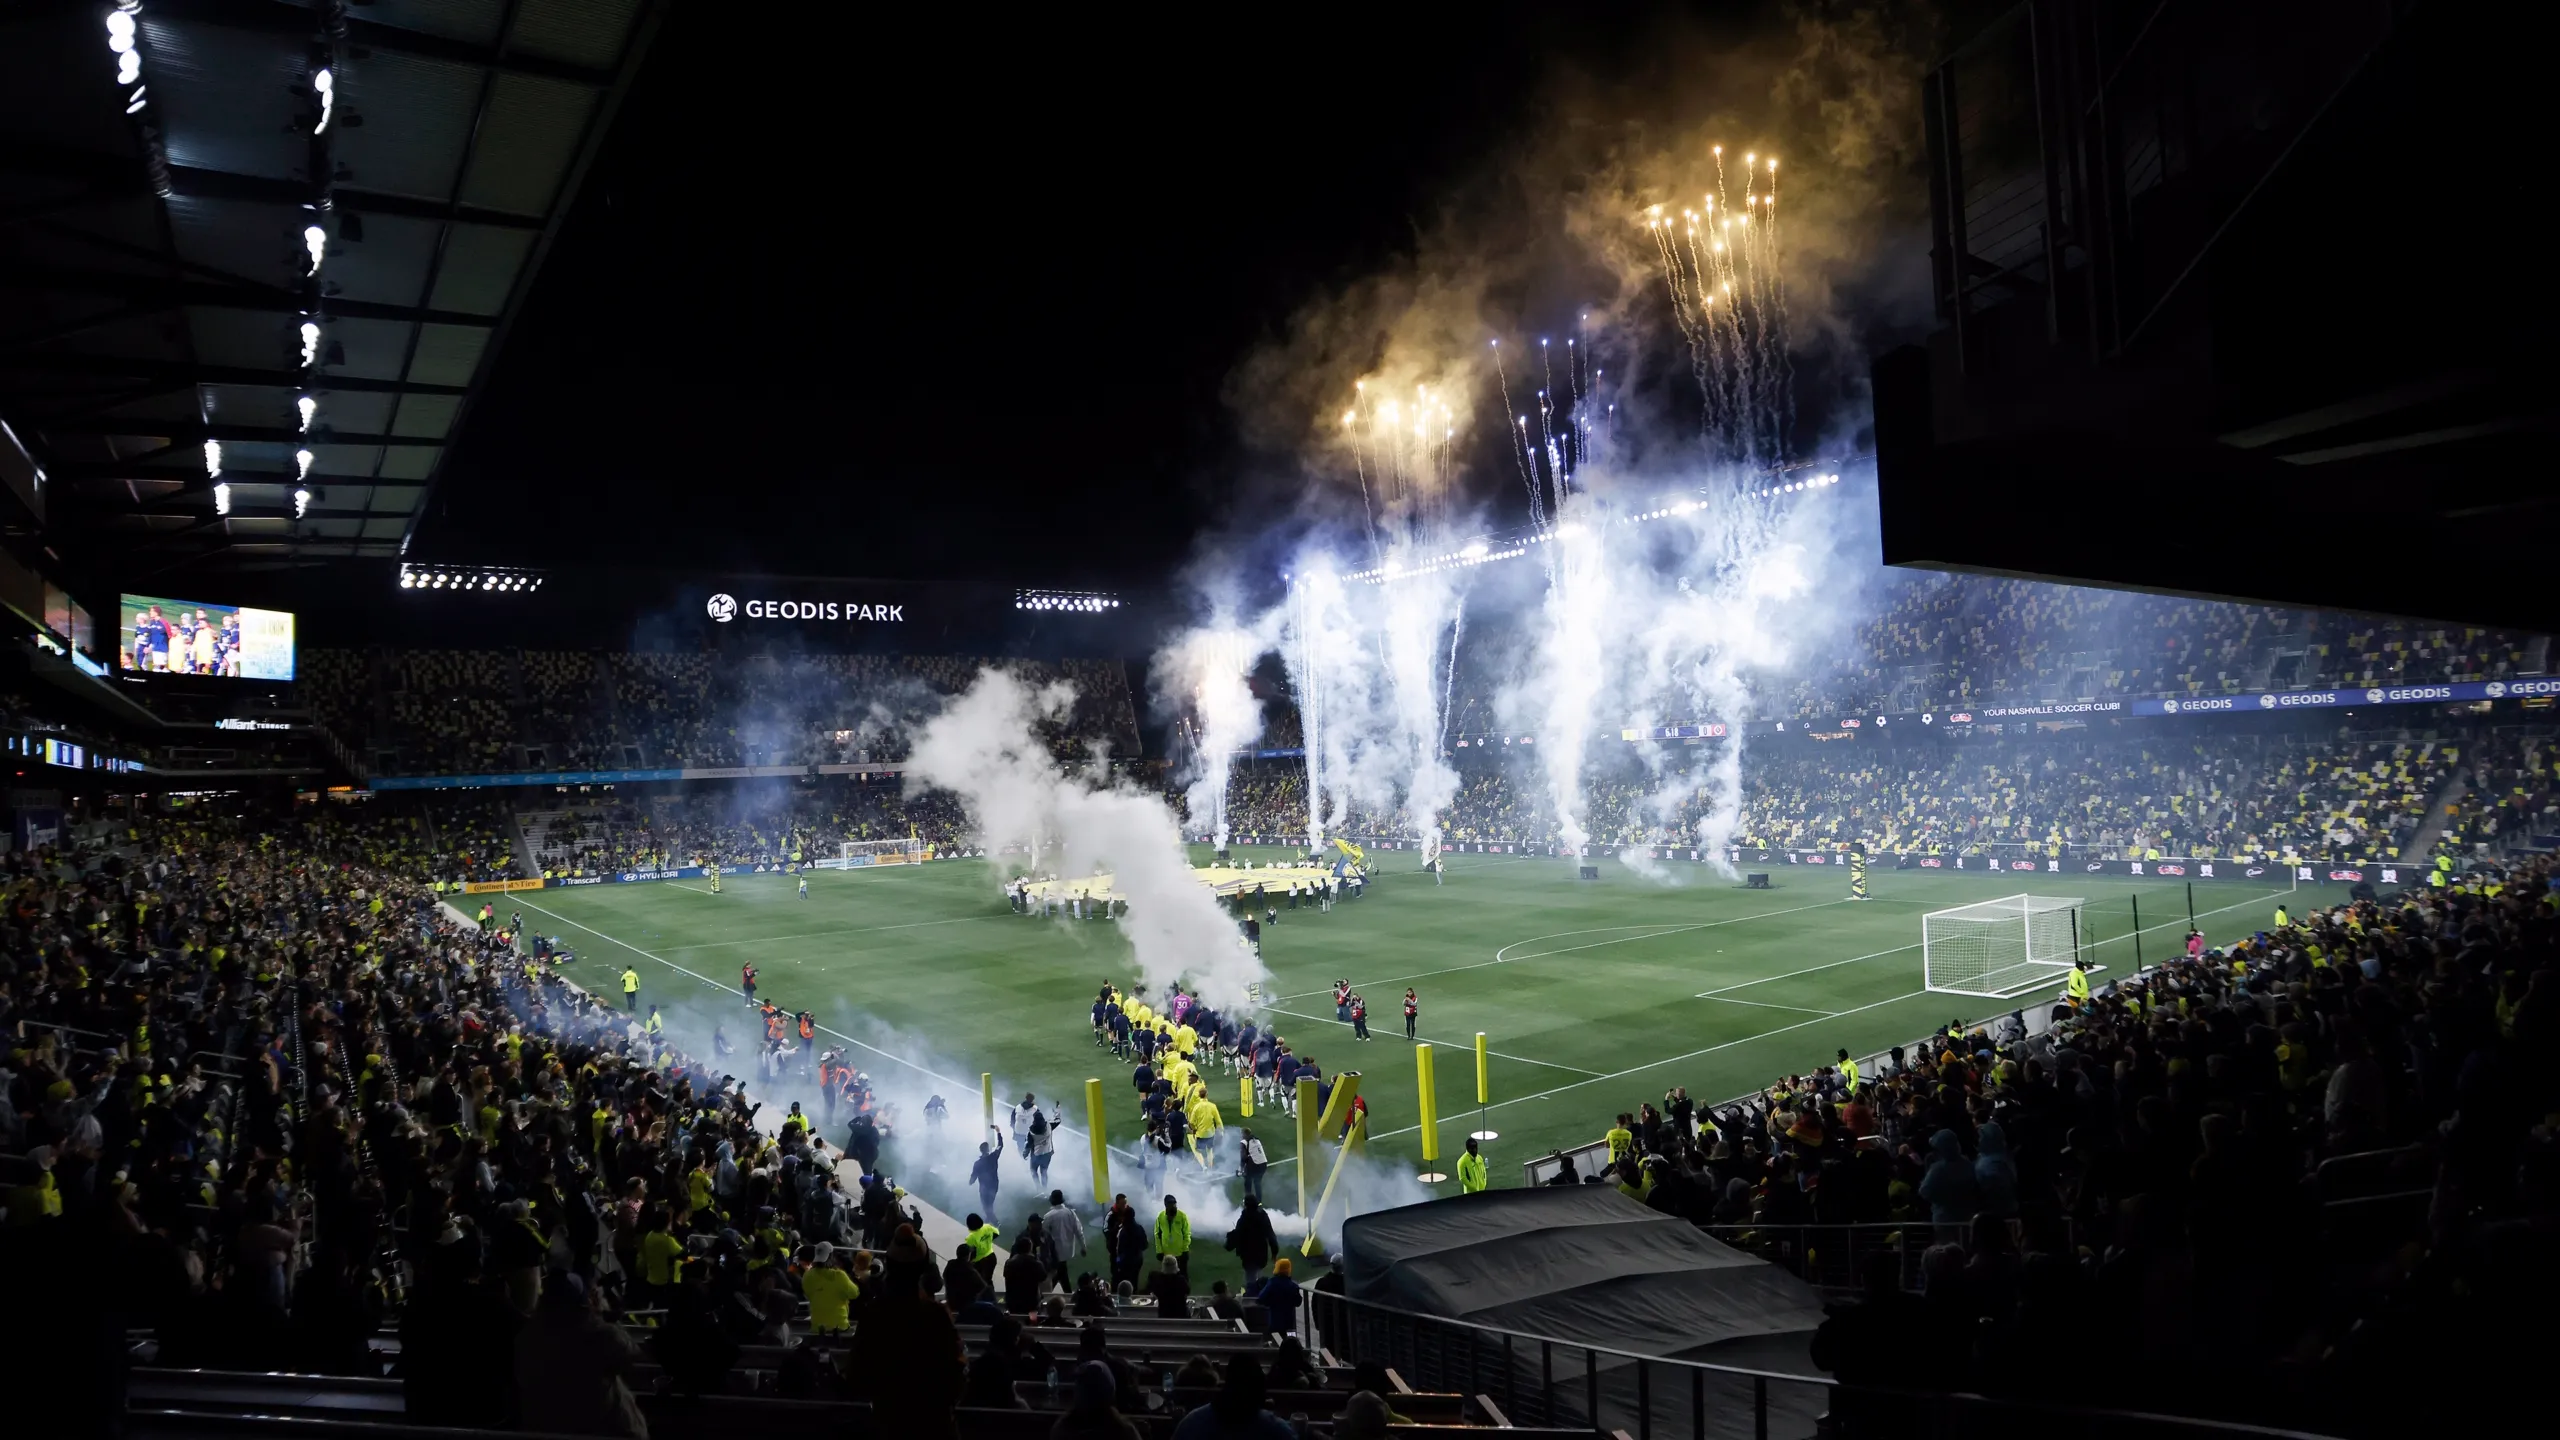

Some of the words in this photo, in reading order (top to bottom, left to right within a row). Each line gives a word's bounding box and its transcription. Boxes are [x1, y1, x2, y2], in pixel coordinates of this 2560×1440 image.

[745, 600, 839, 620] GEODIS
[846, 603, 904, 622] PARK
[2280, 693, 2336, 706] GEODIS
[2389, 687, 2451, 700] GEODIS
[1983, 708, 2007, 717] YOUR
[2008, 706, 2053, 716] NASHVILLE
[2055, 704, 2092, 714] SOCCER
[2094, 702, 2121, 712] CLUB!
[2182, 699, 2233, 710] GEODIS
[219, 718, 257, 731] Alliant
[256, 722, 291, 730] TERRACE
[474, 881, 514, 892] Continenal
[520, 880, 537, 888] Tire
[566, 876, 601, 887] Transcard
[1177, 1001, 1188, 1010] 30
